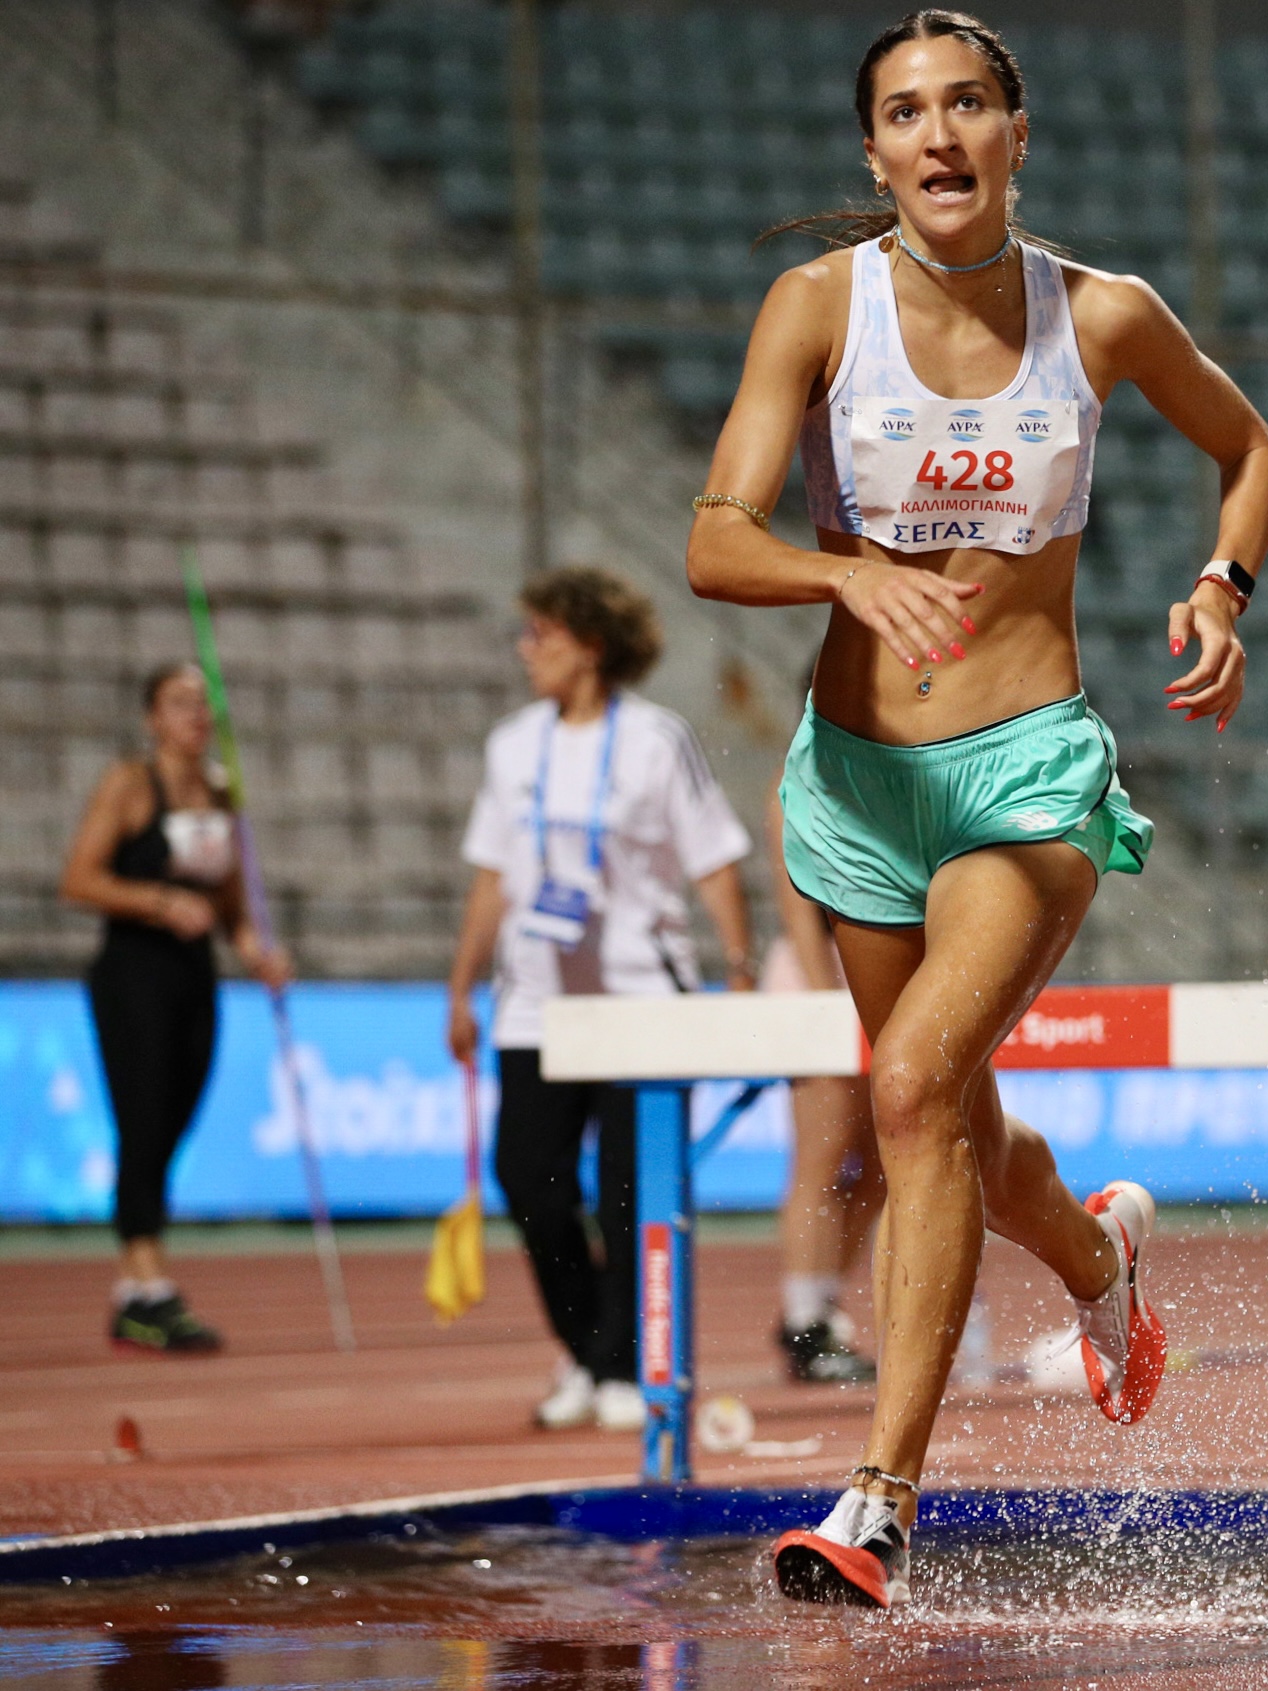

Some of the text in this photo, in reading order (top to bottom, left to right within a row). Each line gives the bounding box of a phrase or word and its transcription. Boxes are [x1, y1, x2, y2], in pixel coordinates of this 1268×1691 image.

[916, 449, 1014, 492] 428
[901, 499, 1028, 516] ΚΑΛΛΙΜΟΓΙΑΝΝΗ
[893, 521, 985, 543] ΣΕΓΑΣ
[1022, 1011, 1105, 1052] Sport
